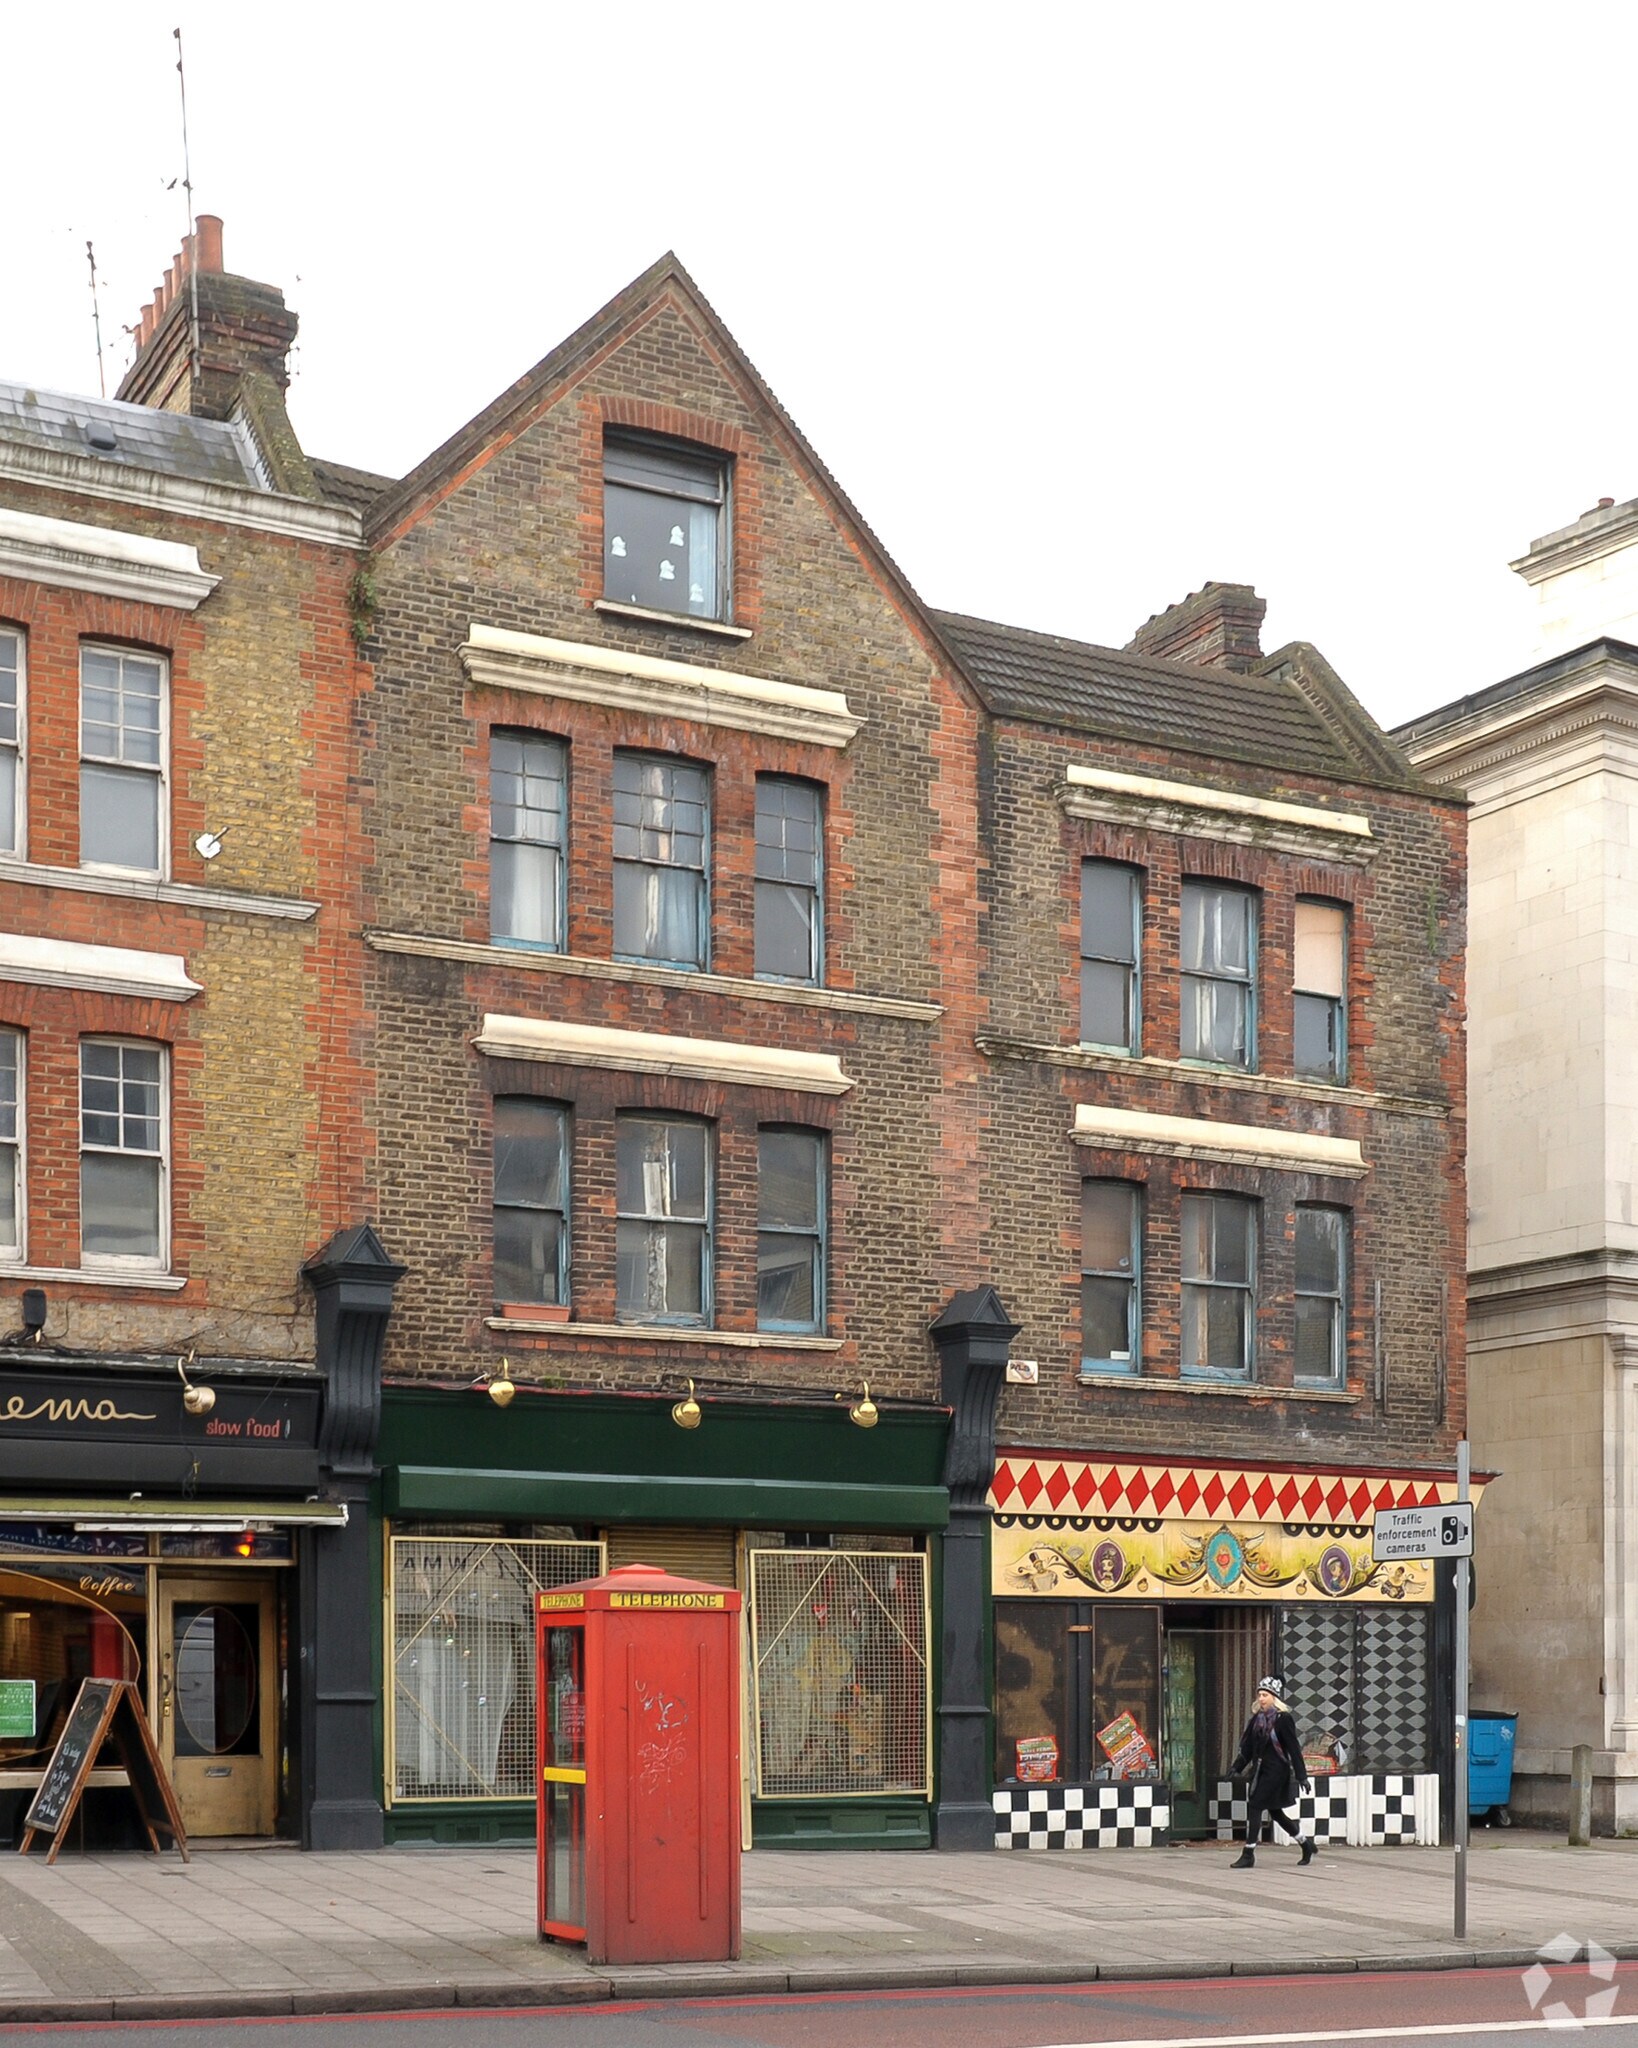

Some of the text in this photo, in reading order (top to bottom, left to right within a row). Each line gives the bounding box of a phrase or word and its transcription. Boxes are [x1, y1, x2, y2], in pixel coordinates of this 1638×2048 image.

[206, 1417, 280, 1438] slow food
[1392, 1514, 1422, 1526] Traffic
[1377, 1527, 1437, 1541] enforcement
[1386, 1543, 1426, 1554] cameras
[80, 1576, 136, 1596] Coffee
[543, 1593, 717, 1608] TELEPHONE TELEPHONE
